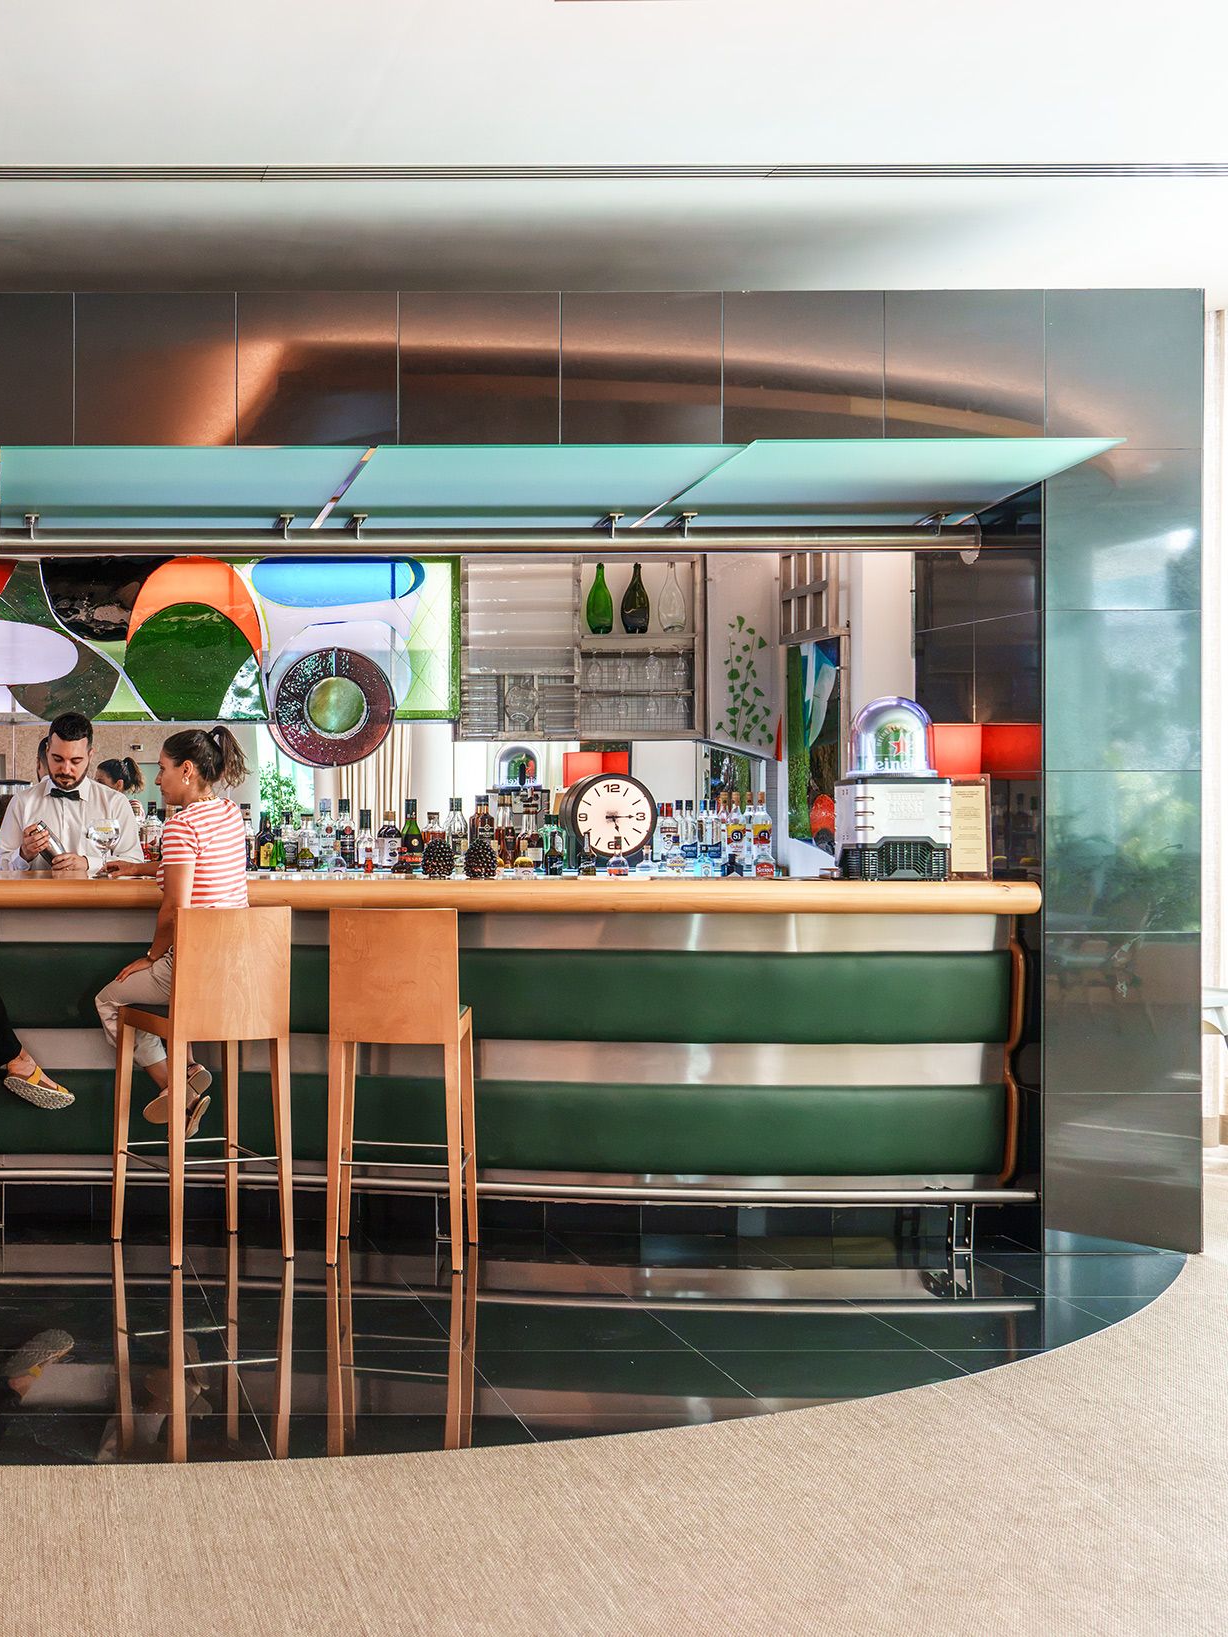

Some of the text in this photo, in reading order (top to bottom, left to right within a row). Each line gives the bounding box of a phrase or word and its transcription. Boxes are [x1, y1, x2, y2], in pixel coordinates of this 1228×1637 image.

[603, 784, 620, 793] 12
[578, 813, 588, 822] 9
[635, 812, 646, 821] 3
[732, 831, 741, 840] 51
